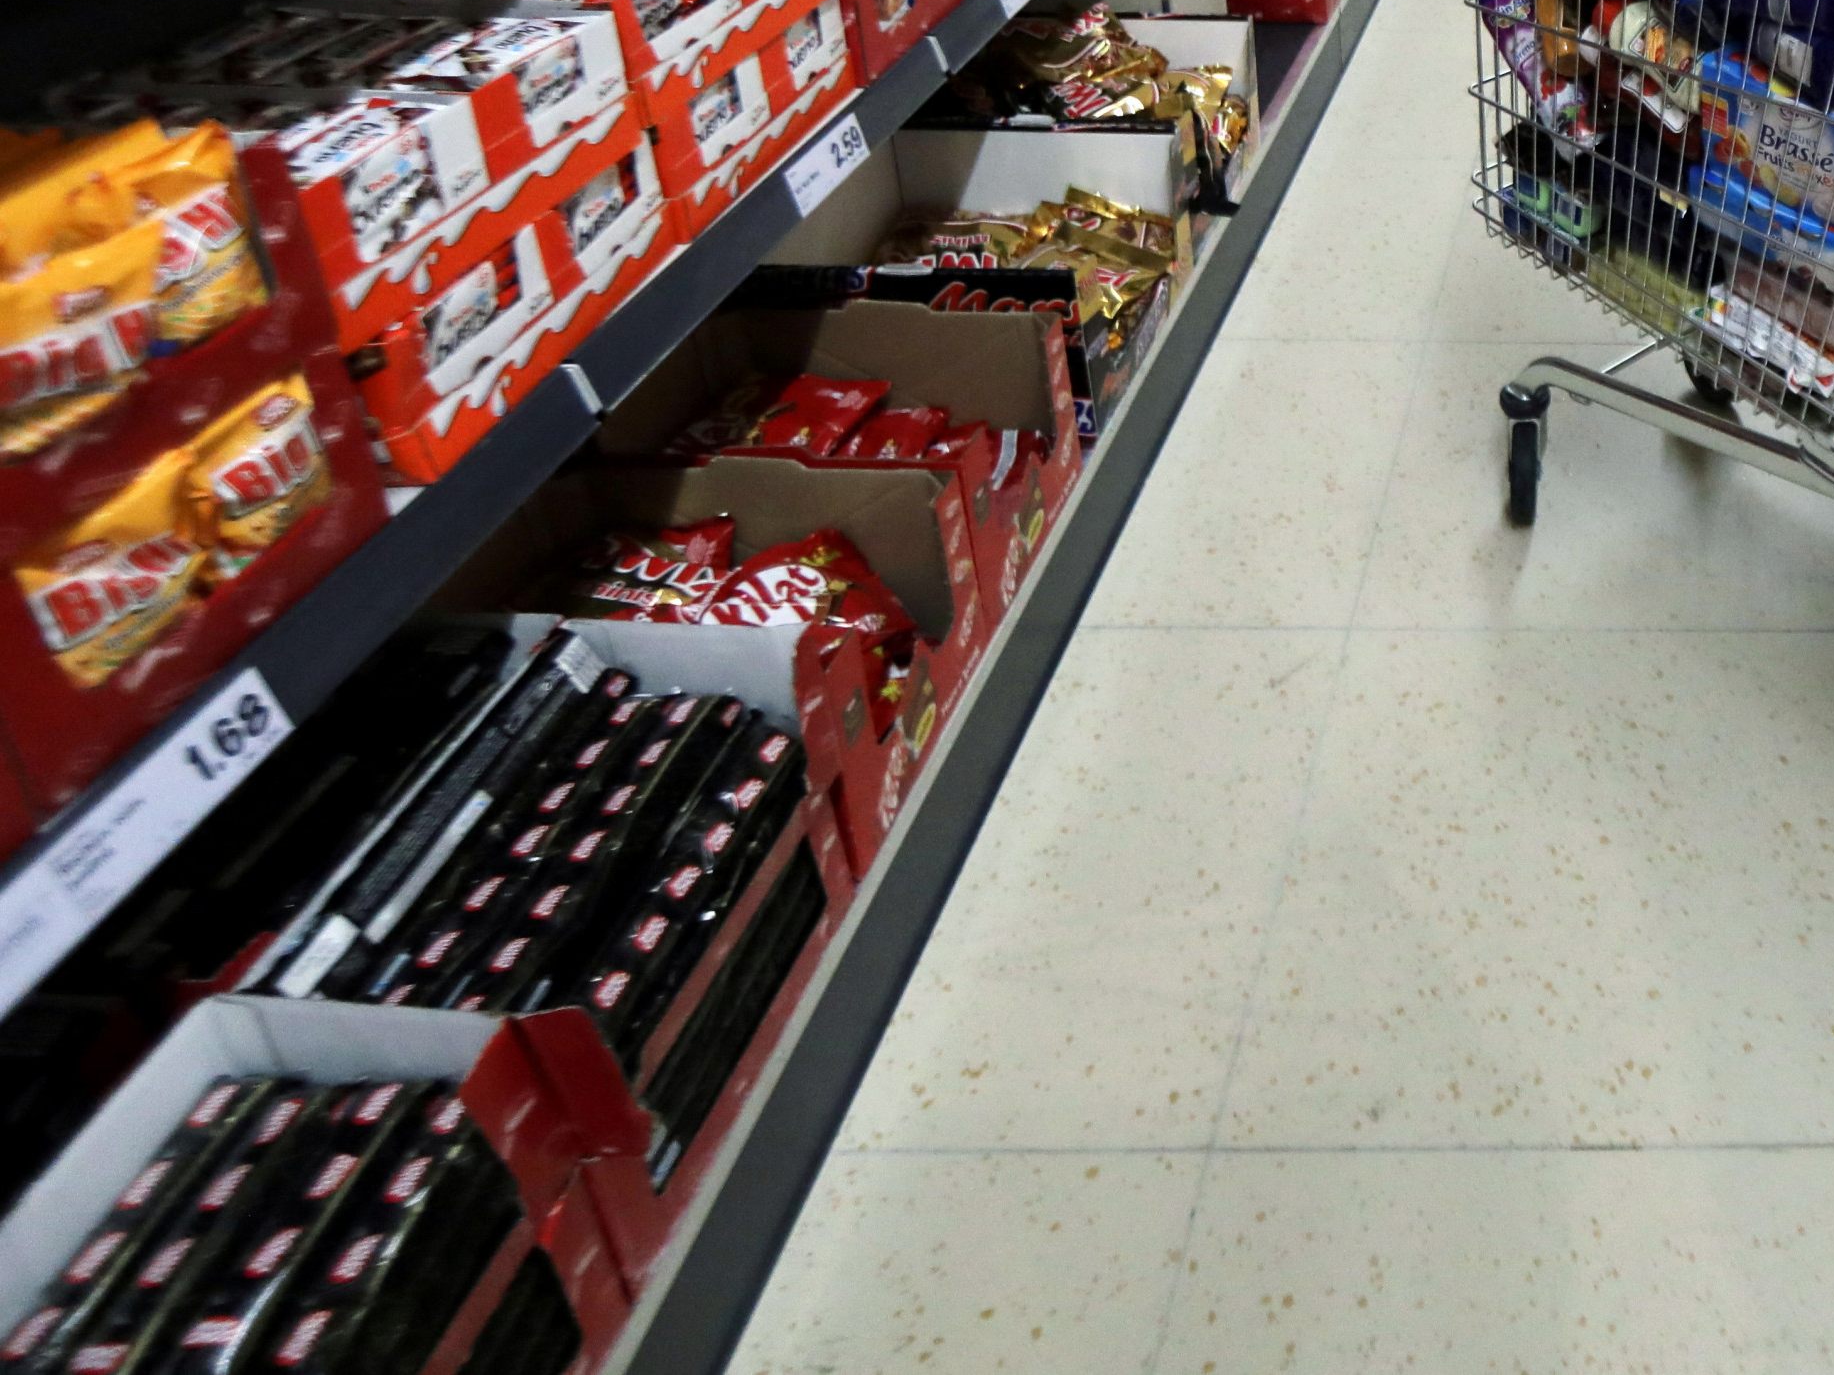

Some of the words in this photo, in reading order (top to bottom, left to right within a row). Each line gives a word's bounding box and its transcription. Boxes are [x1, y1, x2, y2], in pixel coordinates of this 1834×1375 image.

[831, 125, 862, 168] 2.59
[1759, 124, 1834, 173] Brassé
[186, 693, 271, 781] 1.68
